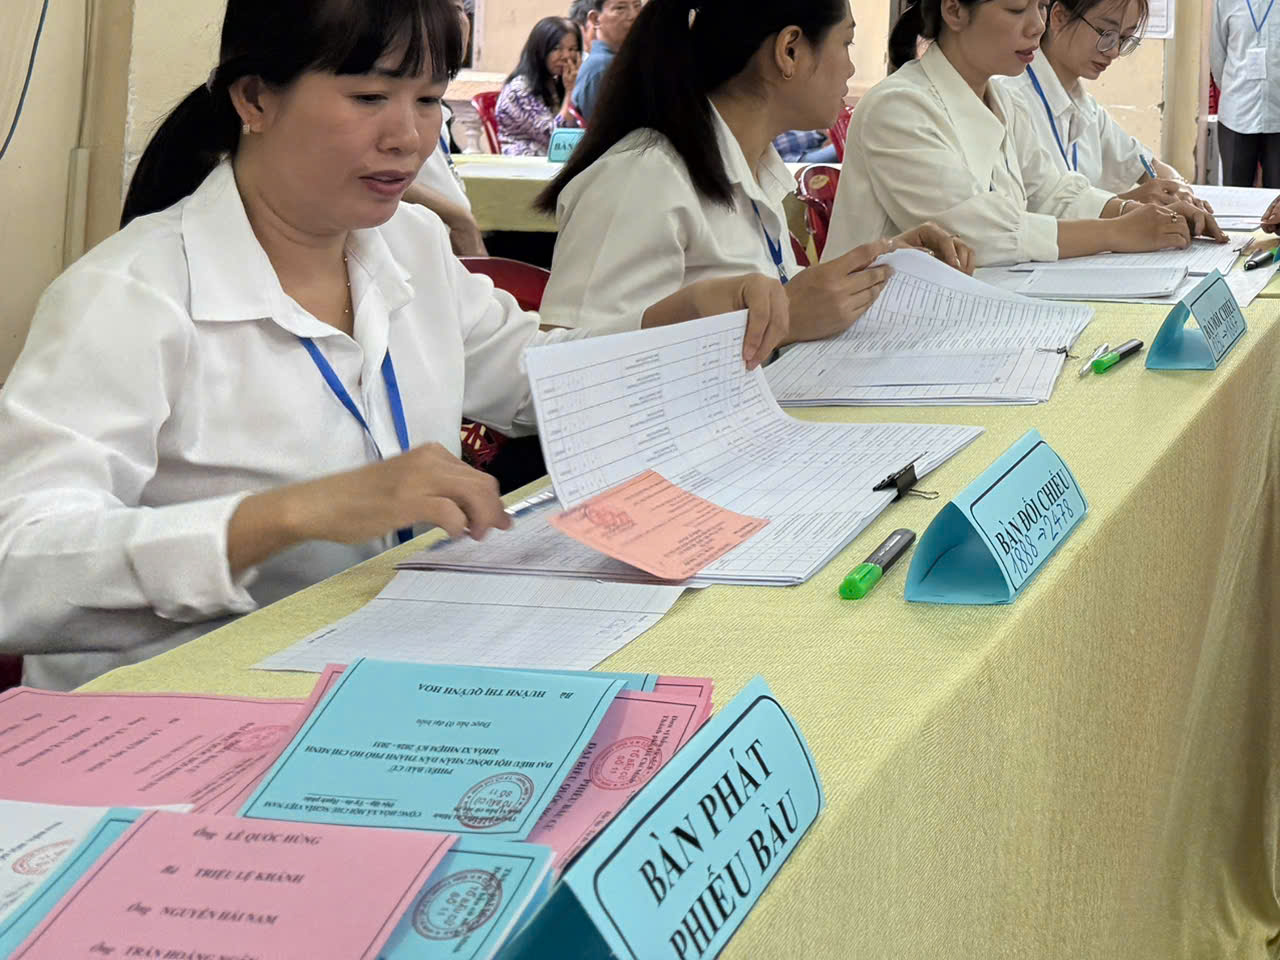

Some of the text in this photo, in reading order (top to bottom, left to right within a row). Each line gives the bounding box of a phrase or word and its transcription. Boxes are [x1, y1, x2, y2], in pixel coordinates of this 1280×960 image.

[995, 469, 1070, 555] BÀN ĐỐI CHIẾU
[1010, 534, 1039, 580] 1888
[418, 683, 442, 693] HOA
[444, 686, 483, 697] QUỲNH
[484, 688, 505, 697] THỊ
[505, 690, 546, 699] HUỲNH
[638, 738, 773, 908] BÀN PHÁT
[668, 788, 800, 960] PHIẾU BẦU
